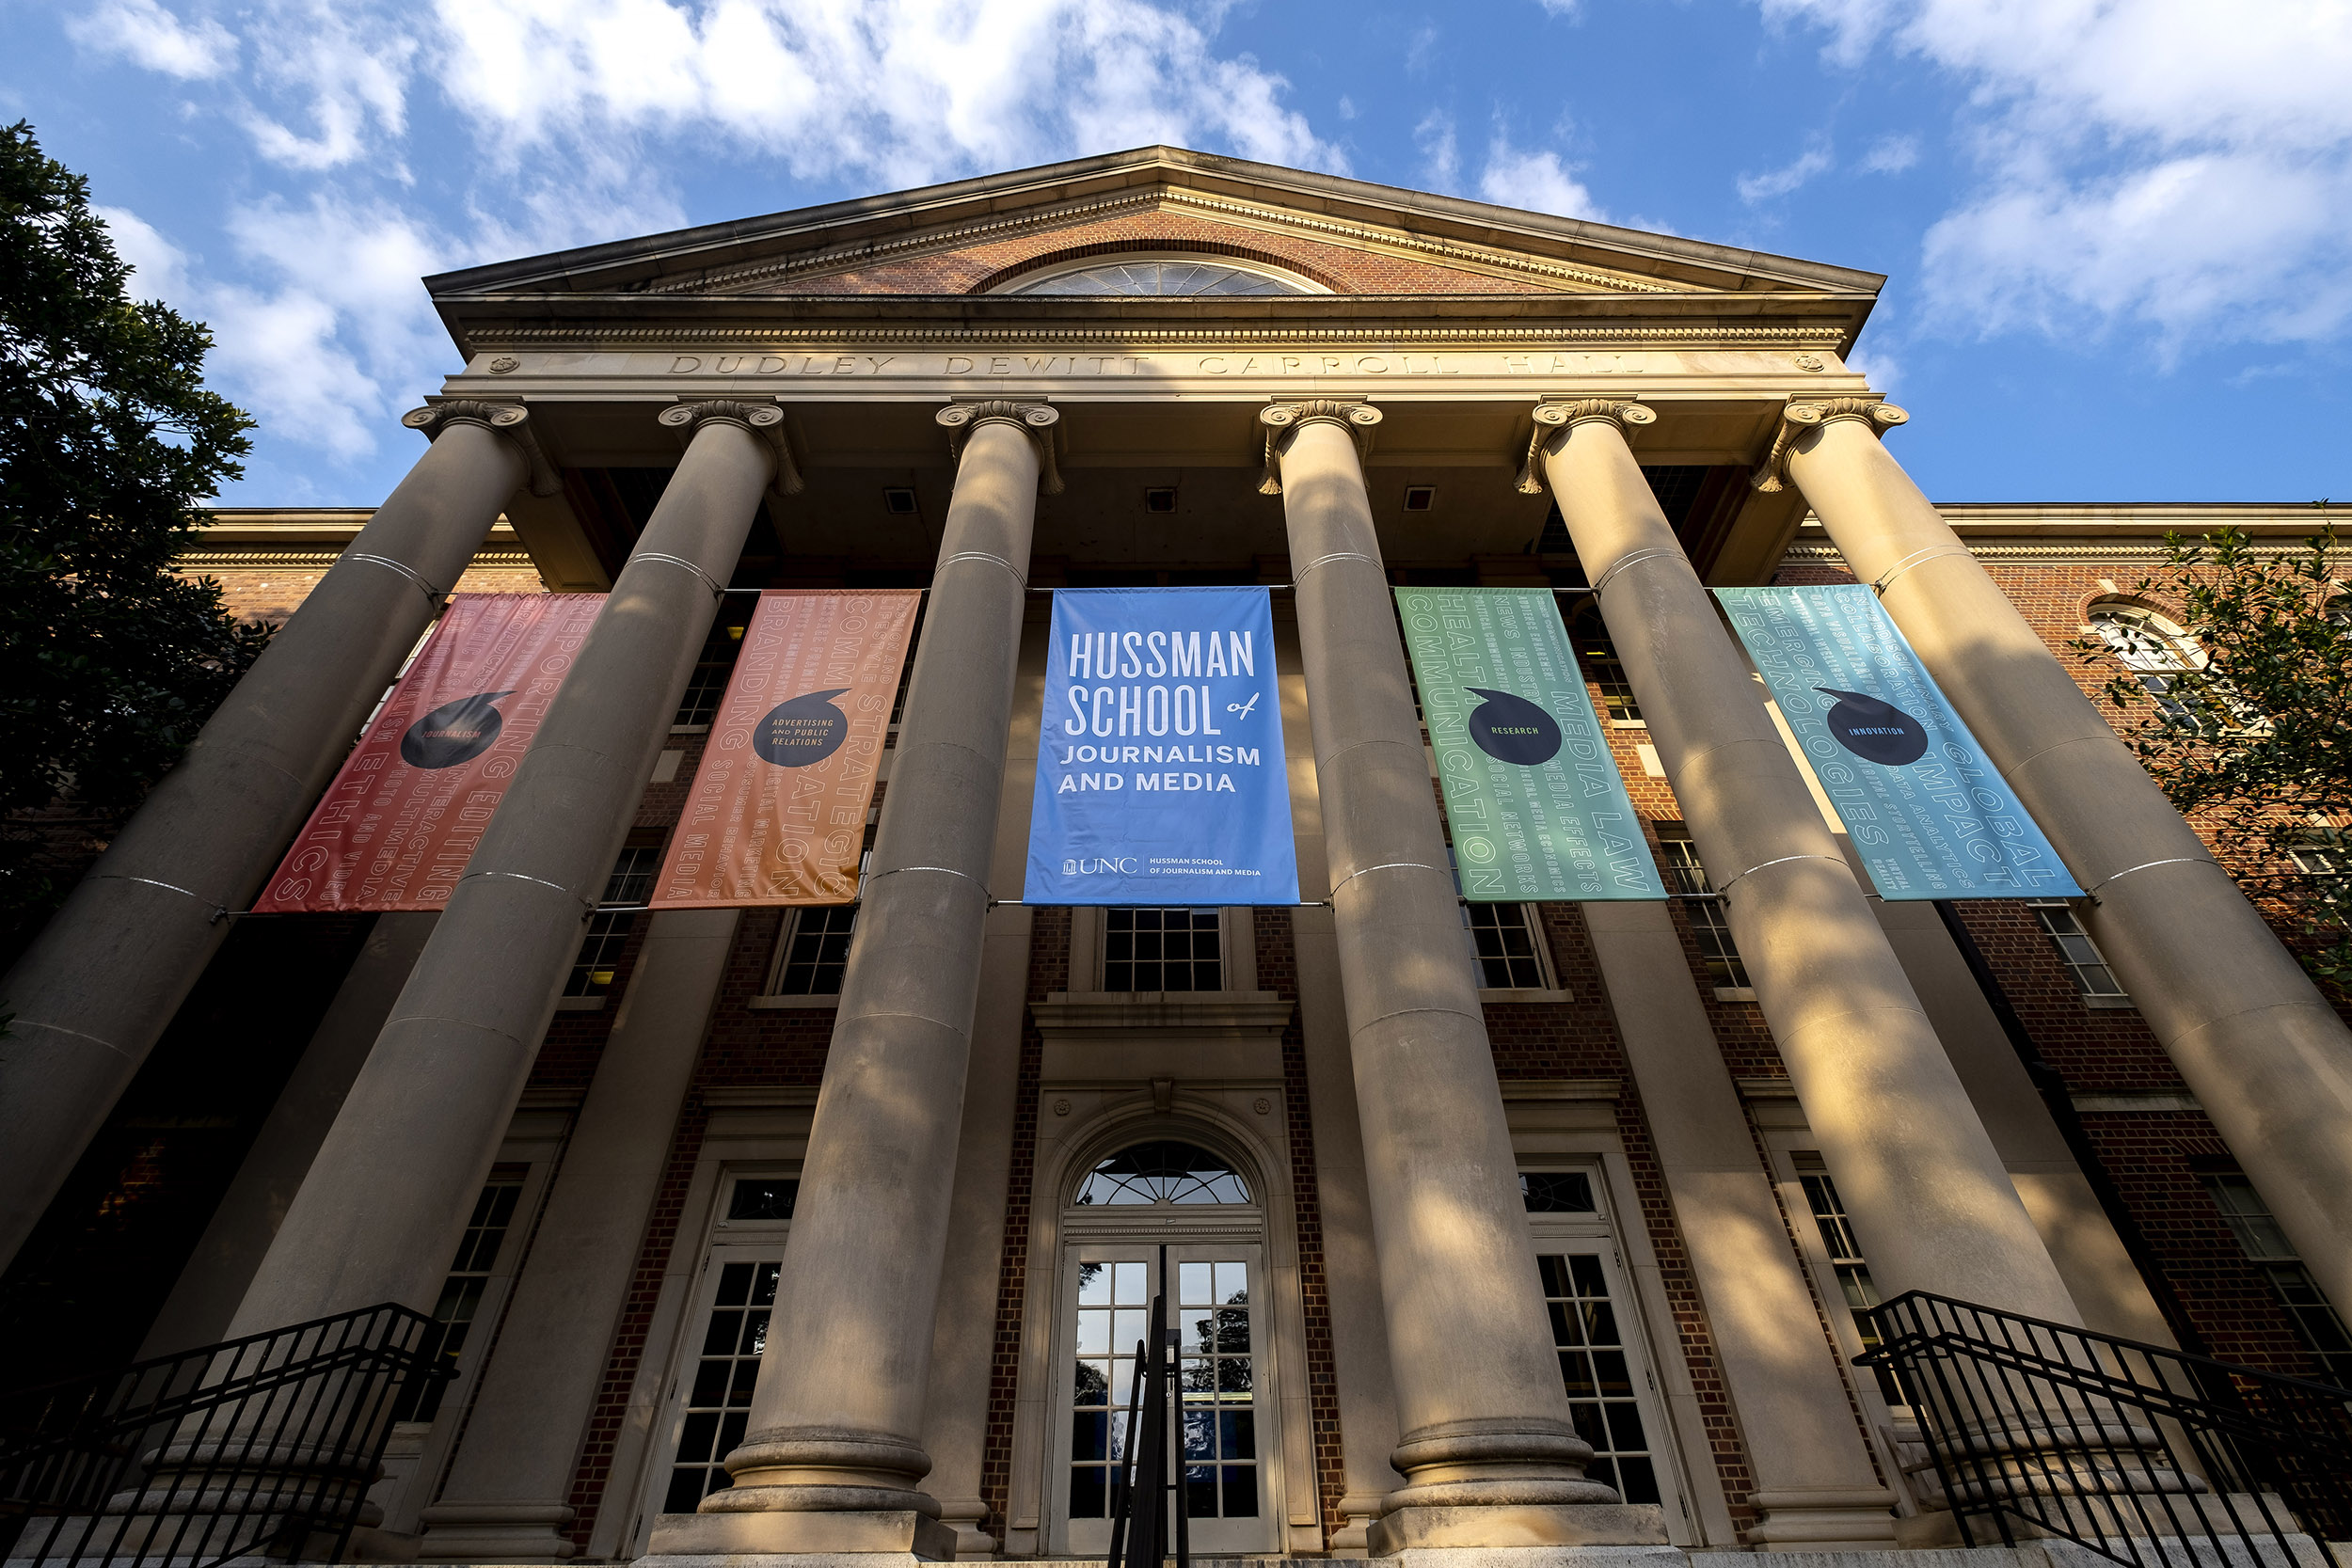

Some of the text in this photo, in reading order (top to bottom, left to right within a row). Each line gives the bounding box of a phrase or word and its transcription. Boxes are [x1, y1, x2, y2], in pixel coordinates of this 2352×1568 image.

[667, 355, 1645, 375] DUDLEY DEWITT CARROLL HALL
[461, 600, 512, 656] GRAPHIC
[813, 597, 839, 642] MESSAGE
[860, 596, 897, 683] LIFESTYLE
[879, 596, 911, 685] FASHION AND
[1068, 630, 1255, 680] HUSSMAN
[1473, 594, 1492, 630] POLITICAL
[1492, 595, 1520, 640] NEWS
[1517, 595, 1538, 631] AUDIENCE
[1757, 594, 1840, 711] EMERGING
[1788, 594, 1820, 637] ARTIFICIAL
[1808, 594, 1887, 701] DATA VISUALIZATION
[1834, 593, 1937, 731] COLLABORATION
[1850, 592, 1955, 733] INTERDISCIPLINARY
[372, 600, 483, 743] DATA JOURNALISM
[483, 600, 603, 779] REPORTING
[719, 597, 797, 751] BRANDING
[771, 719, 834, 727] ADVERTISING
[1064, 684, 1261, 737] SCHOOL of
[1727, 594, 1890, 846] TECHNOLOGIES
[421, 730, 482, 738] JOURNALISM
[767, 596, 873, 897] COMMATION
[1057, 772, 1236, 795] AND MEDIA
[1059, 744, 1261, 767] JOURNALISM
[1406, 594, 1506, 894] COMMUNICATION
[1490, 726, 1539, 735] RESEARCH
[1848, 727, 1905, 736] INNOVATION
[274, 752, 389, 902] ETHICS
[320, 760, 411, 901] PHOTO AND VIDEO
[356, 768, 438, 901] MULTIMEDIA
[381, 762, 470, 901] INTERACTIVE
[416, 790, 503, 901] EDITING
[667, 759, 734, 899] SOCIAL MEDIA
[707, 752, 760, 898] CONSUMER BEHAVIOR
[734, 765, 786, 897] DIGITAL MARKETING
[813, 693, 887, 896] STRATEGIC
[1486, 756, 1539, 894] SOCIAL NETWORKS
[1542, 759, 1603, 893] MEDIA EFFECTS
[1550, 690, 1650, 892] MEDIA LAW
[1883, 764, 1975, 889] DATA ANALYTICS
[1883, 801, 1947, 890] STORYTELLING
[1942, 741, 2056, 887] GLOBAL
[1079, 857, 1138, 875] UNC
[1528, 800, 1548, 832] MEDIA
[1538, 833, 1566, 894] ECONOMICS
[1871, 858, 1899, 891] REALITY
[1884, 857, 1912, 890] VIRTUAL
